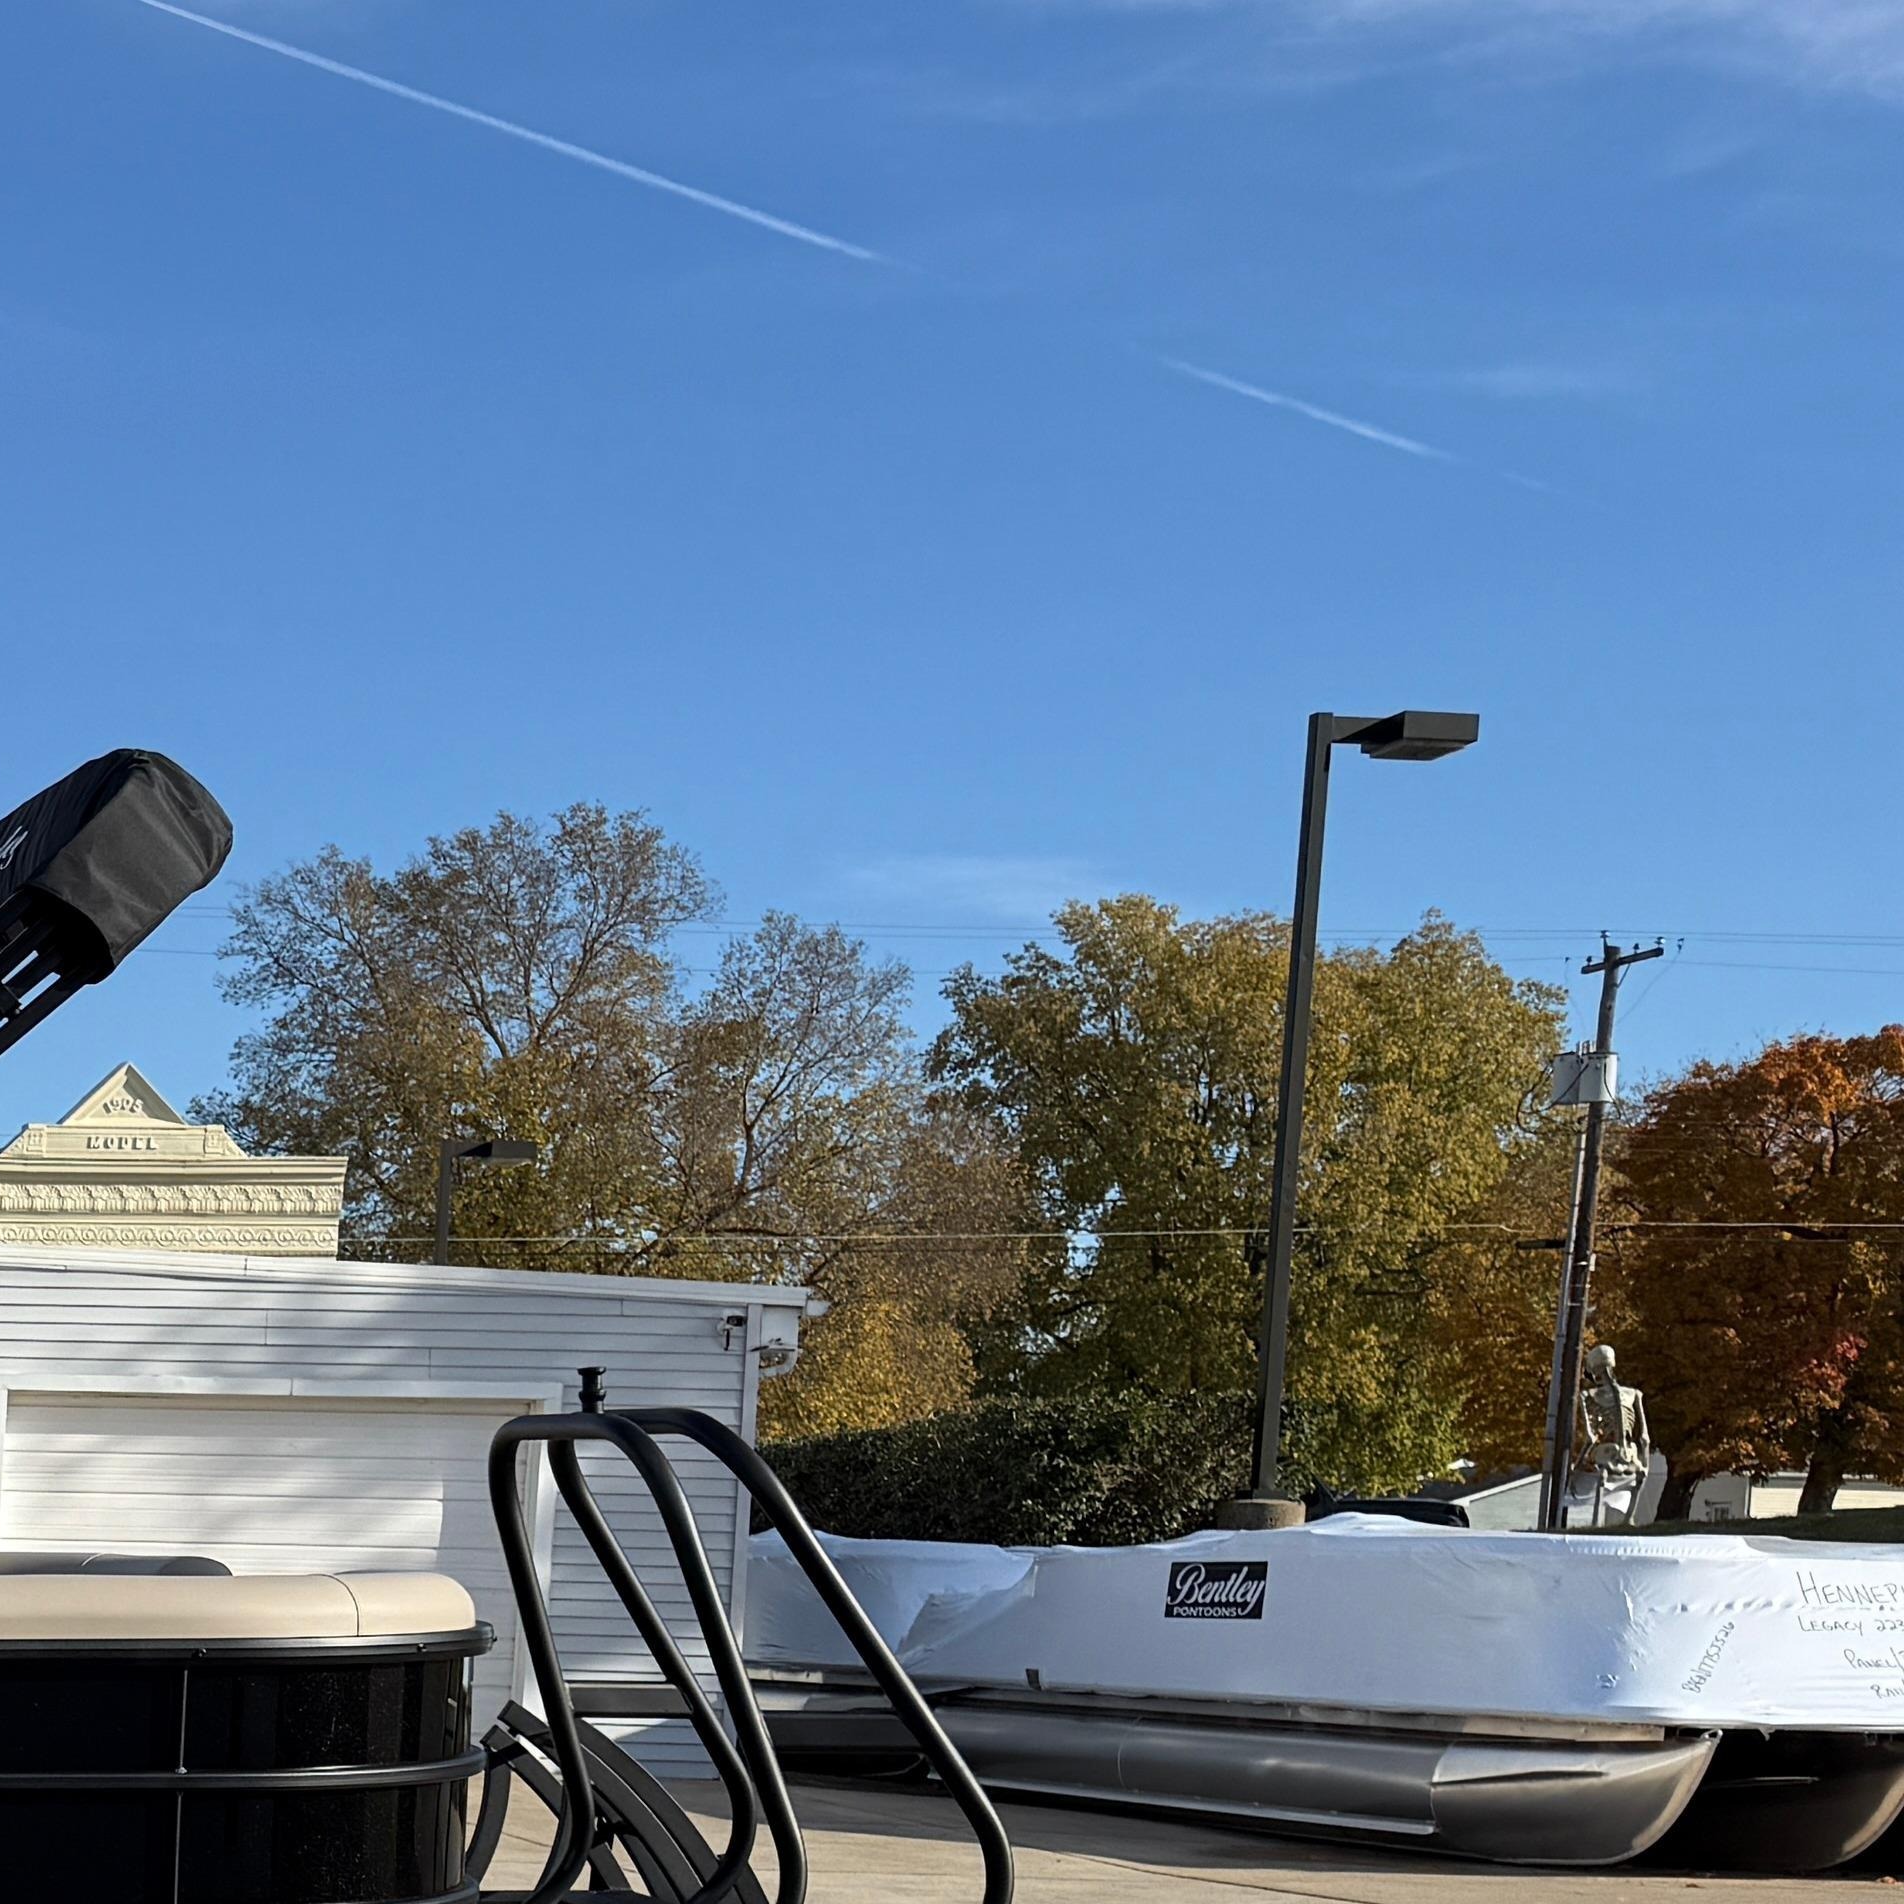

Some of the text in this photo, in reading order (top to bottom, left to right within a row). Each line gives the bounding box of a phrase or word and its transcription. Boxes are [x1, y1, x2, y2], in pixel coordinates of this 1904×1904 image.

[86, 1136, 160, 1151] MODEL
[1168, 1563, 1265, 1615] Bentley
[1173, 1606, 1237, 1617] PONTOONS
[1798, 1615, 1863, 1636] LEGACY
